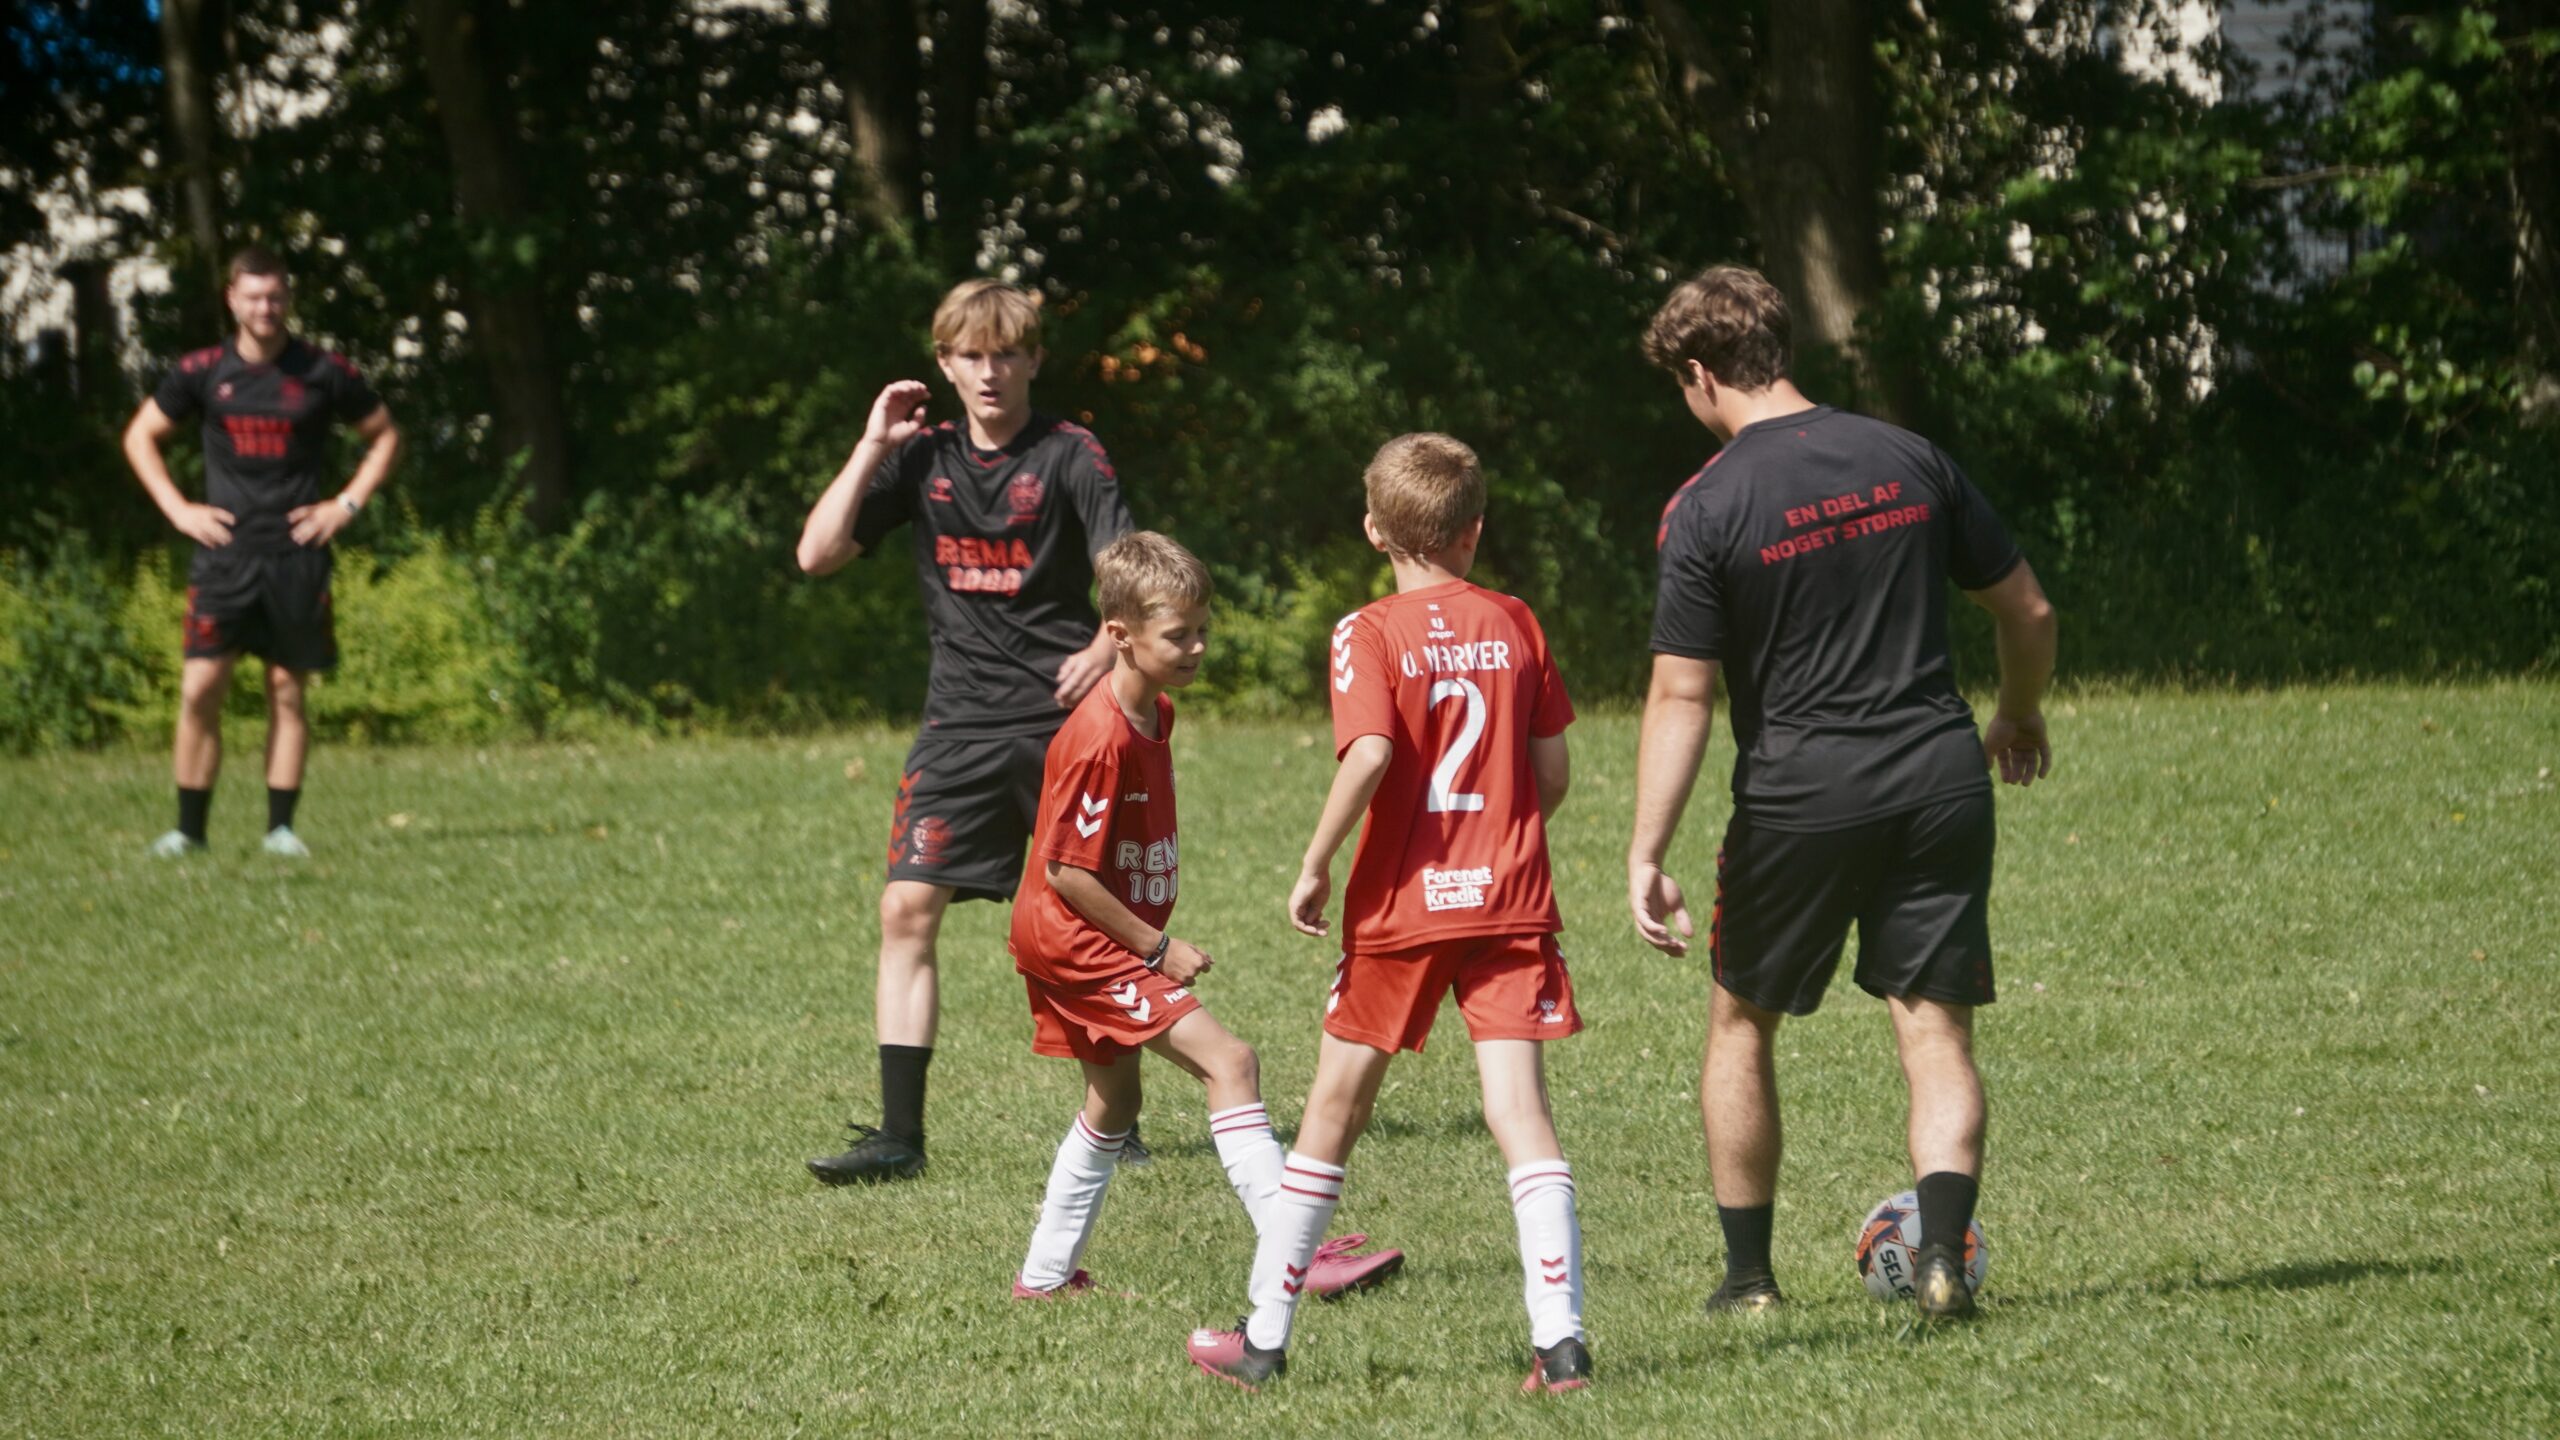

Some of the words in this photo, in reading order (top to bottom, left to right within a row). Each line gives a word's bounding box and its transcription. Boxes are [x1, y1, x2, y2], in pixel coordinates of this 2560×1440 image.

[1784, 504, 1819, 528] EN
[1821, 492, 1870, 518] DEL
[1872, 481, 1902, 504] AF
[935, 534, 1034, 569] REMA
[1759, 526, 1836, 565] NOGET
[1841, 503, 1931, 540] STØRRE
[1427, 677, 1487, 812] 2
[1422, 865, 1493, 886] Forenet
[1424, 884, 1485, 908] Kredit
